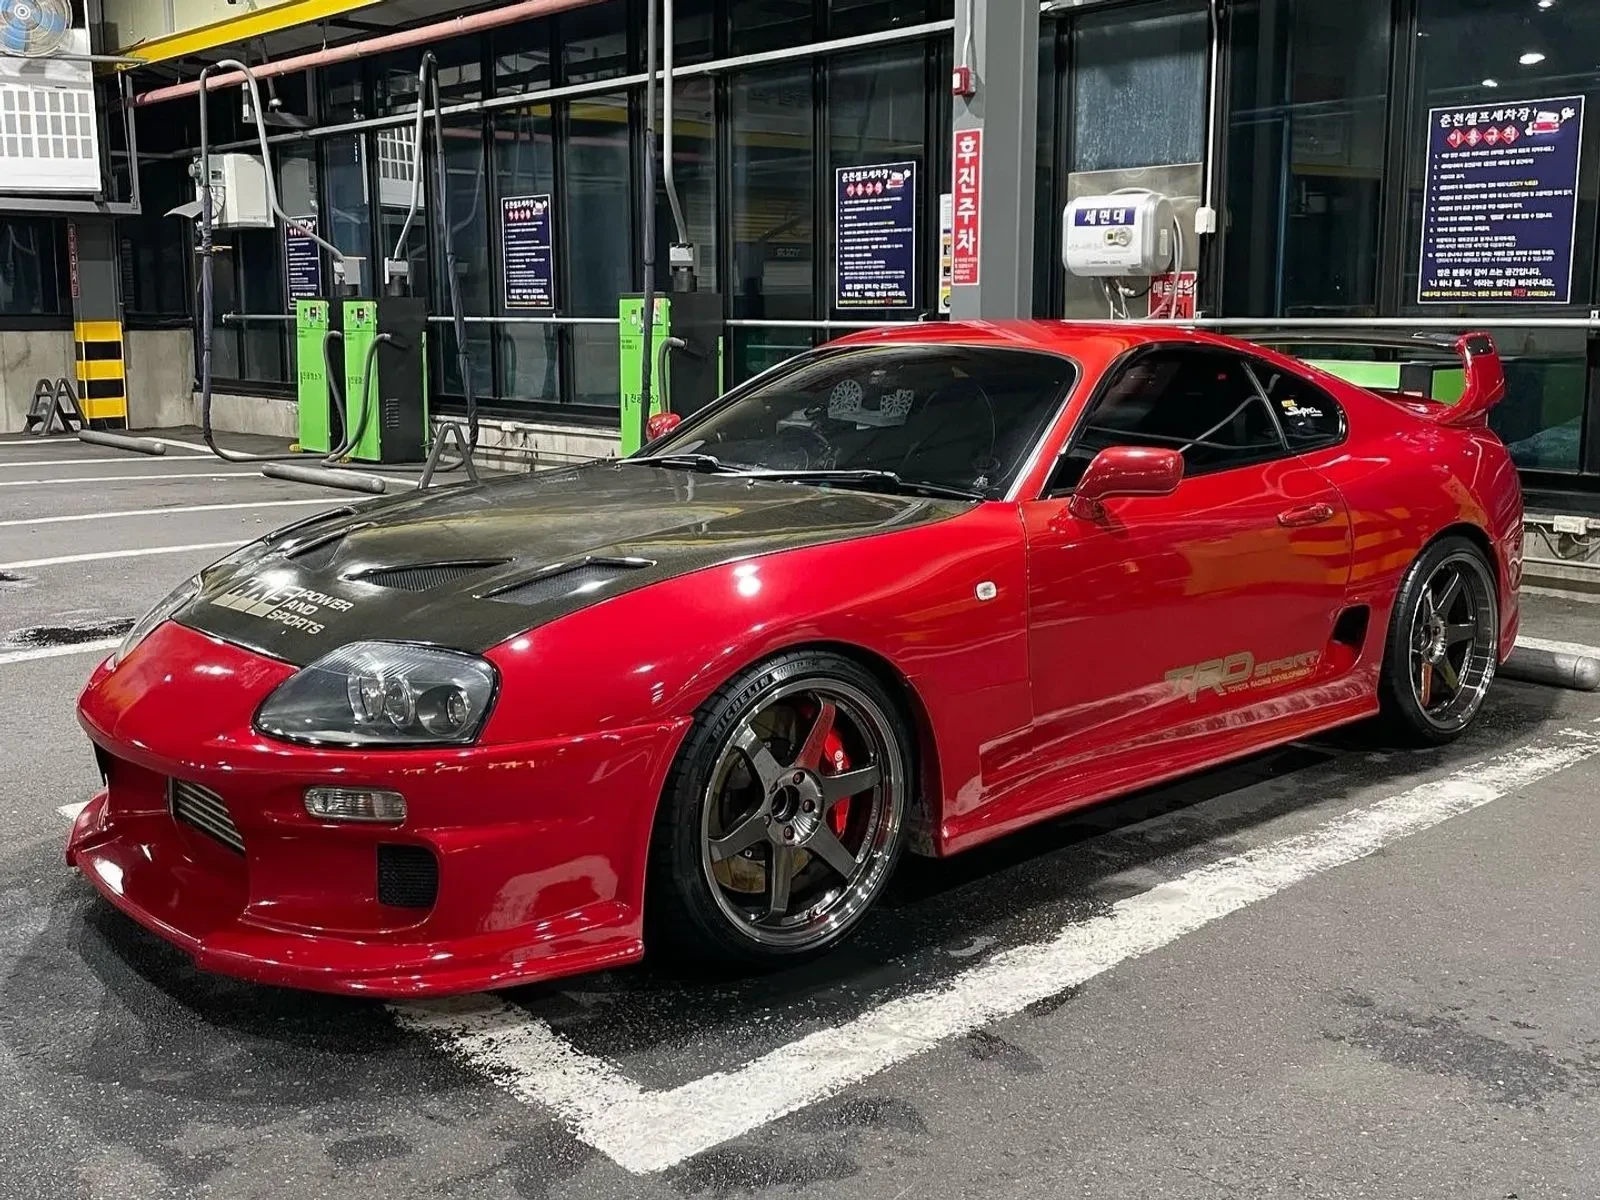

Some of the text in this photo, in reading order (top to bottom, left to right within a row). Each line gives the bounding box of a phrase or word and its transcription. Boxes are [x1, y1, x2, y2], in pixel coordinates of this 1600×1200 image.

[1440, 107, 1530, 128] 춘천셀프세차장
[957, 136, 976, 255] 후진주차
[1084, 208, 1125, 225] 세면대
[282, 599, 319, 615] AND
[299, 590, 354, 612] POWER
[266, 609, 326, 635] SPORTS
[1165, 650, 1320, 703] TRD SPORT
[1227, 681, 1250, 694] TOYOTA
[712, 676, 770, 738] MICHELIN
